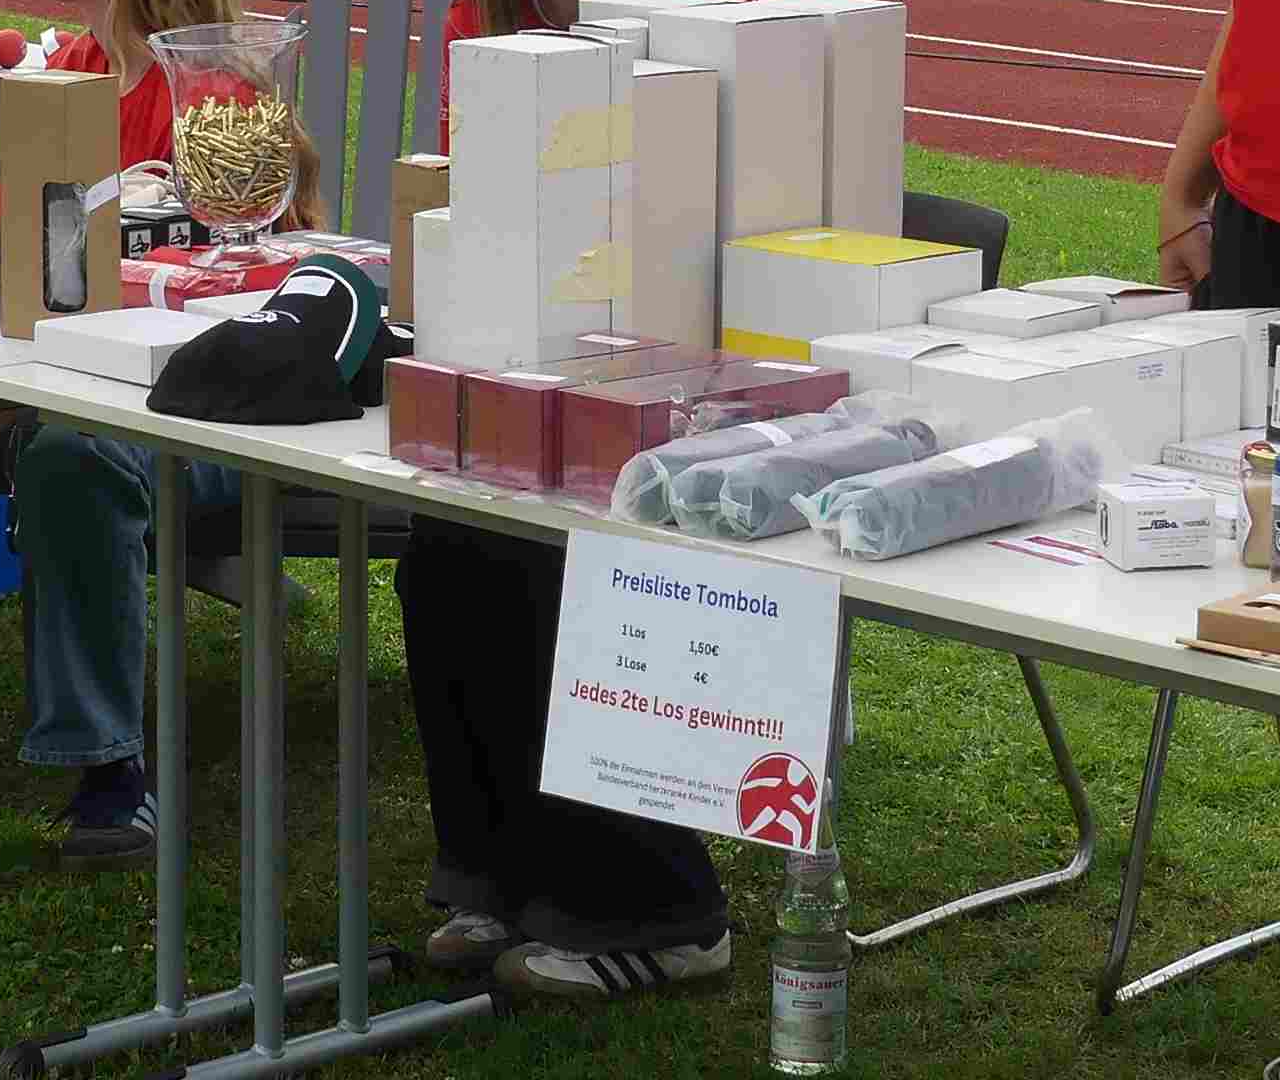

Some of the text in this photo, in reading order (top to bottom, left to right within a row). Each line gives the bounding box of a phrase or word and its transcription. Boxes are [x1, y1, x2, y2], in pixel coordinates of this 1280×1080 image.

[611, 568, 779, 618] Preisliste Tombola
[621, 624, 647, 639] 1 Los
[688, 640, 720, 657] 1,50€
[615, 656, 647, 672] 3 Lose
[693, 671, 709, 684] 4€
[569, 678, 784, 742] Jedes 2te Los gewinnt!!!
